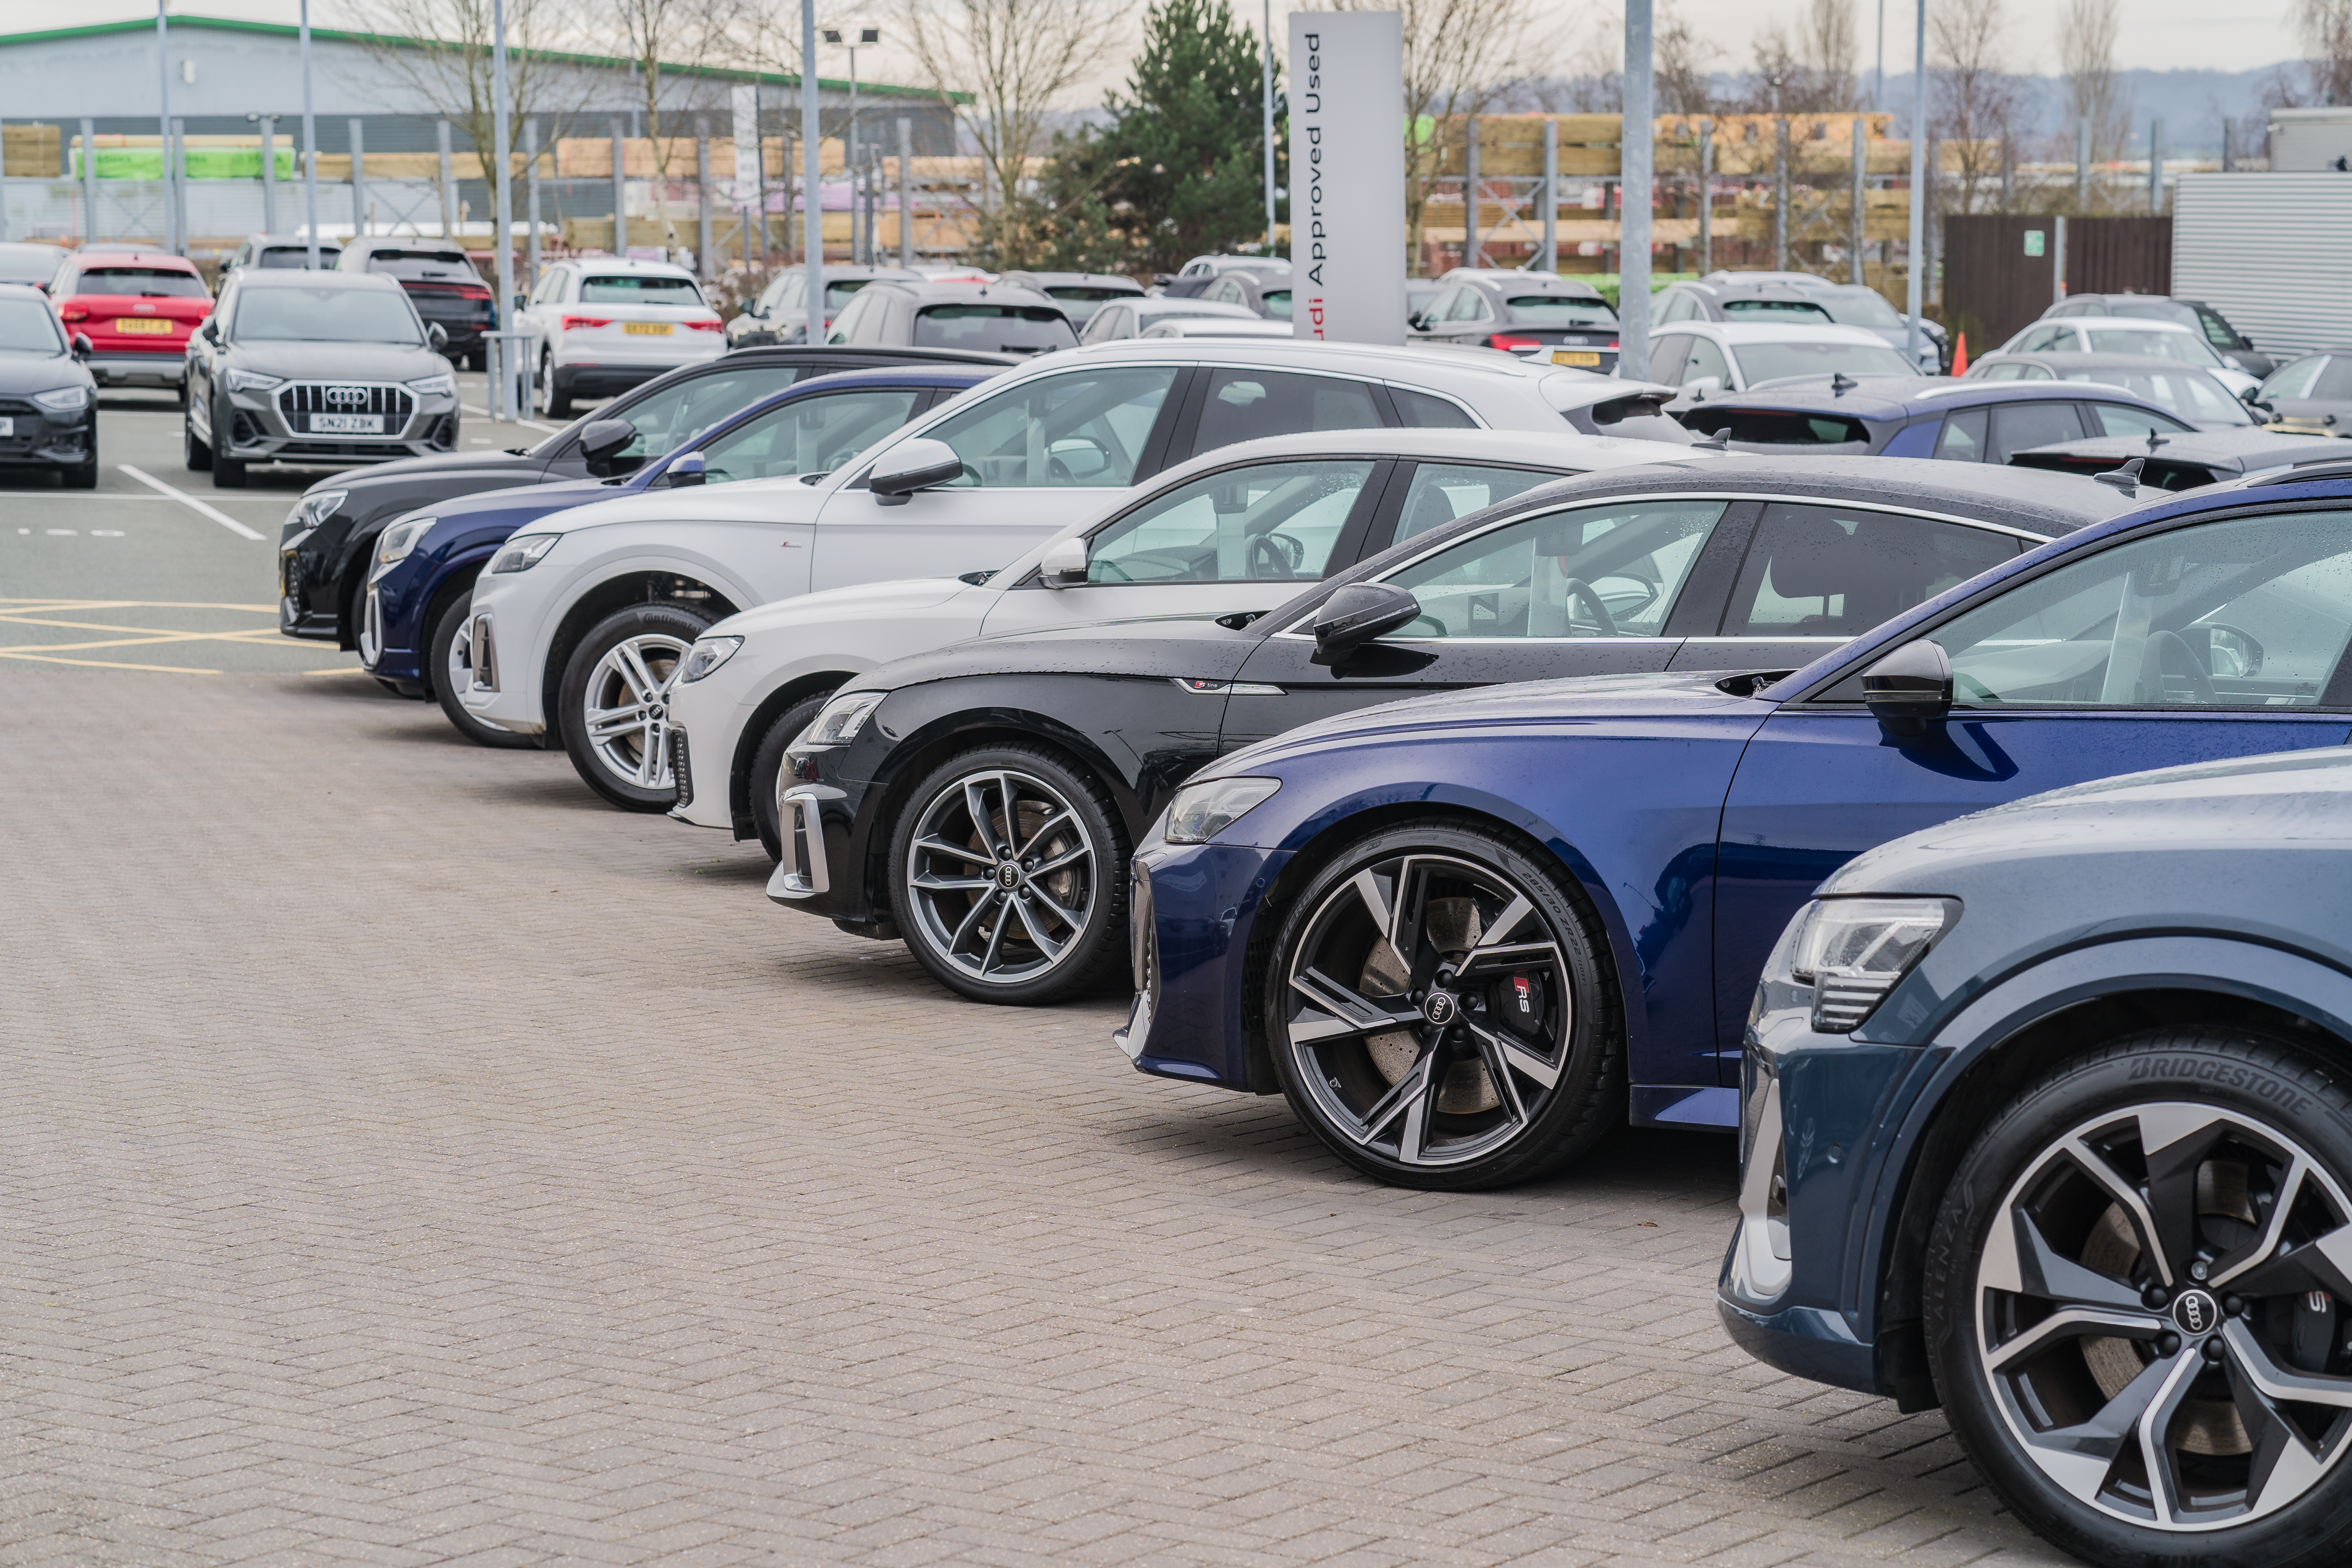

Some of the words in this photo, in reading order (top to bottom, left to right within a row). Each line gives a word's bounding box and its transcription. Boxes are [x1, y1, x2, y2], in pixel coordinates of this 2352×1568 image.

[1304, 34, 1320, 113] Used
[1306, 127, 1327, 286] Approved
[1309, 298, 1324, 341] udi
[319, 417, 347, 428] SN21
[1282, 889, 1311, 945] ZERO
[1522, 872, 1562, 914] 285/30
[1559, 918, 1581, 956] ZR22
[1517, 985, 1530, 1013] RS
[2128, 1057, 2312, 1115] BRIDGESTONE
[2308, 1290, 2327, 1313] S
